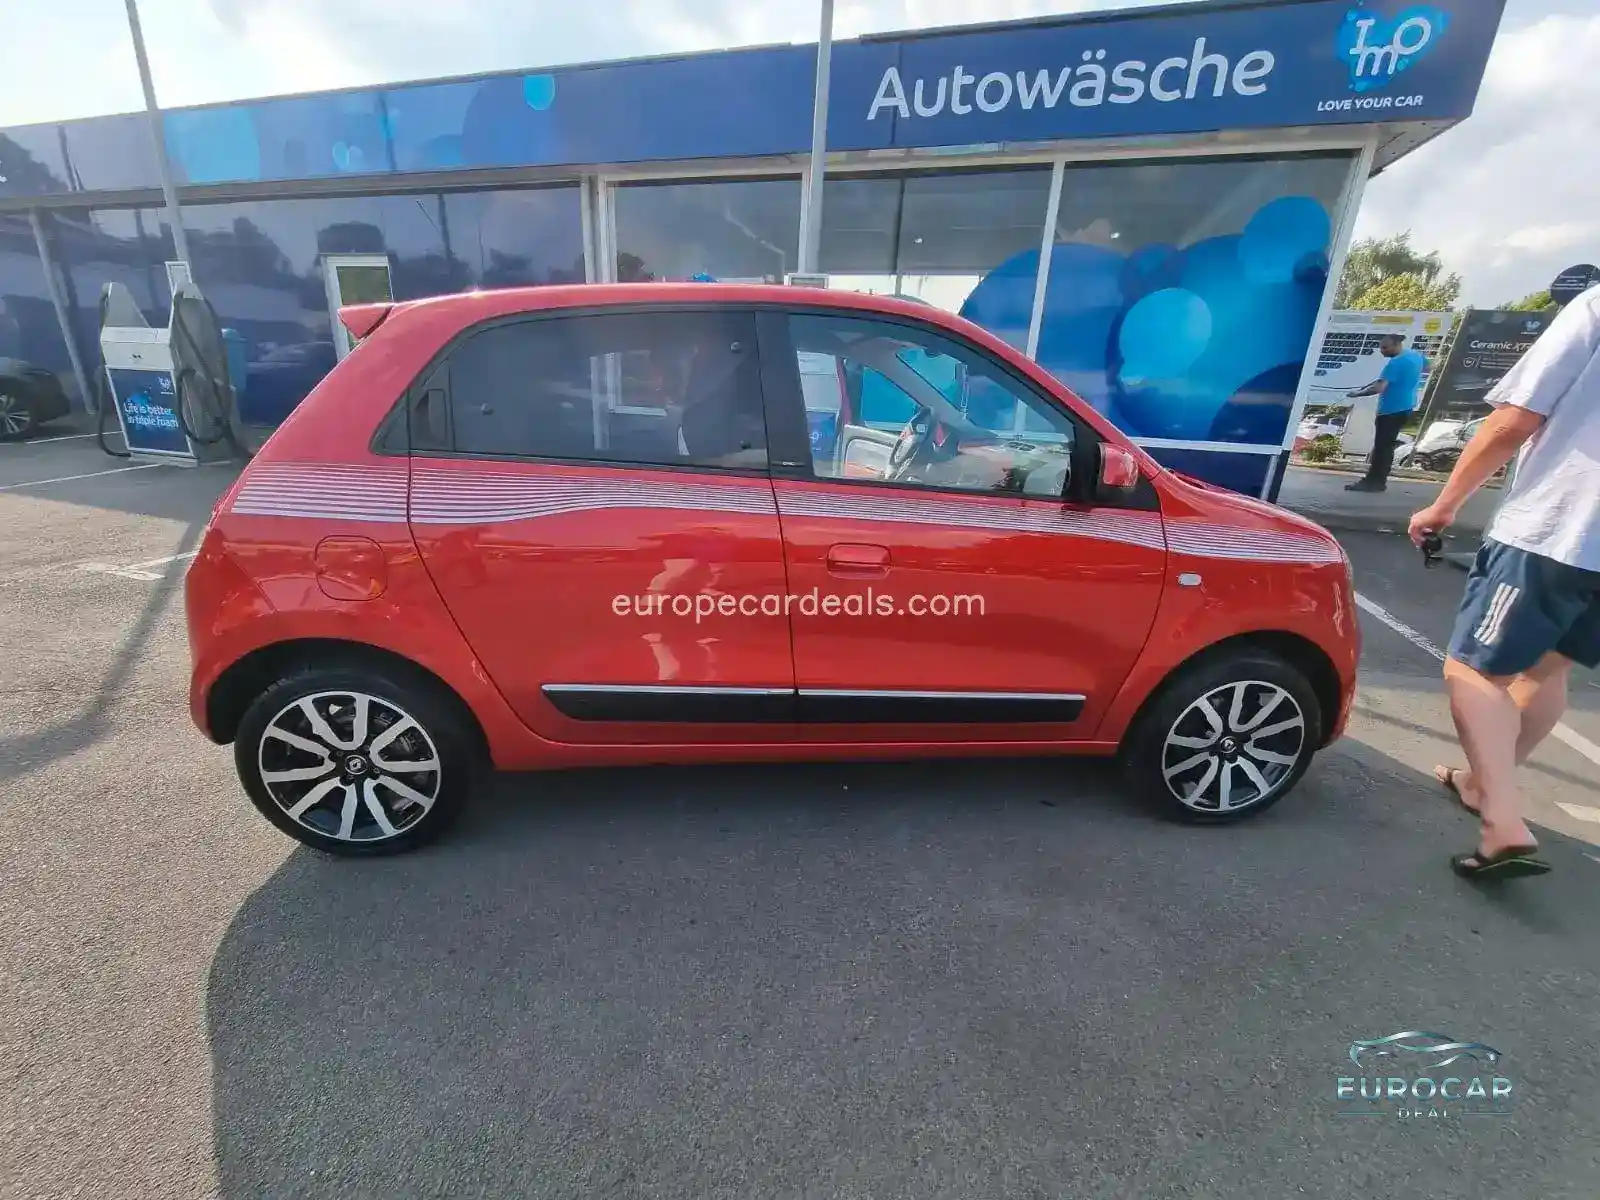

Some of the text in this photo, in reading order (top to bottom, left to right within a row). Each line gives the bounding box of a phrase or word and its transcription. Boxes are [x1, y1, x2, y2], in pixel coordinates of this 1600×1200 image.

[866, 37, 1274, 121] Autowäsche
[1317, 94, 1424, 112] LOVE YOUR CAR
[1470, 340, 1513, 351] Ceramic
